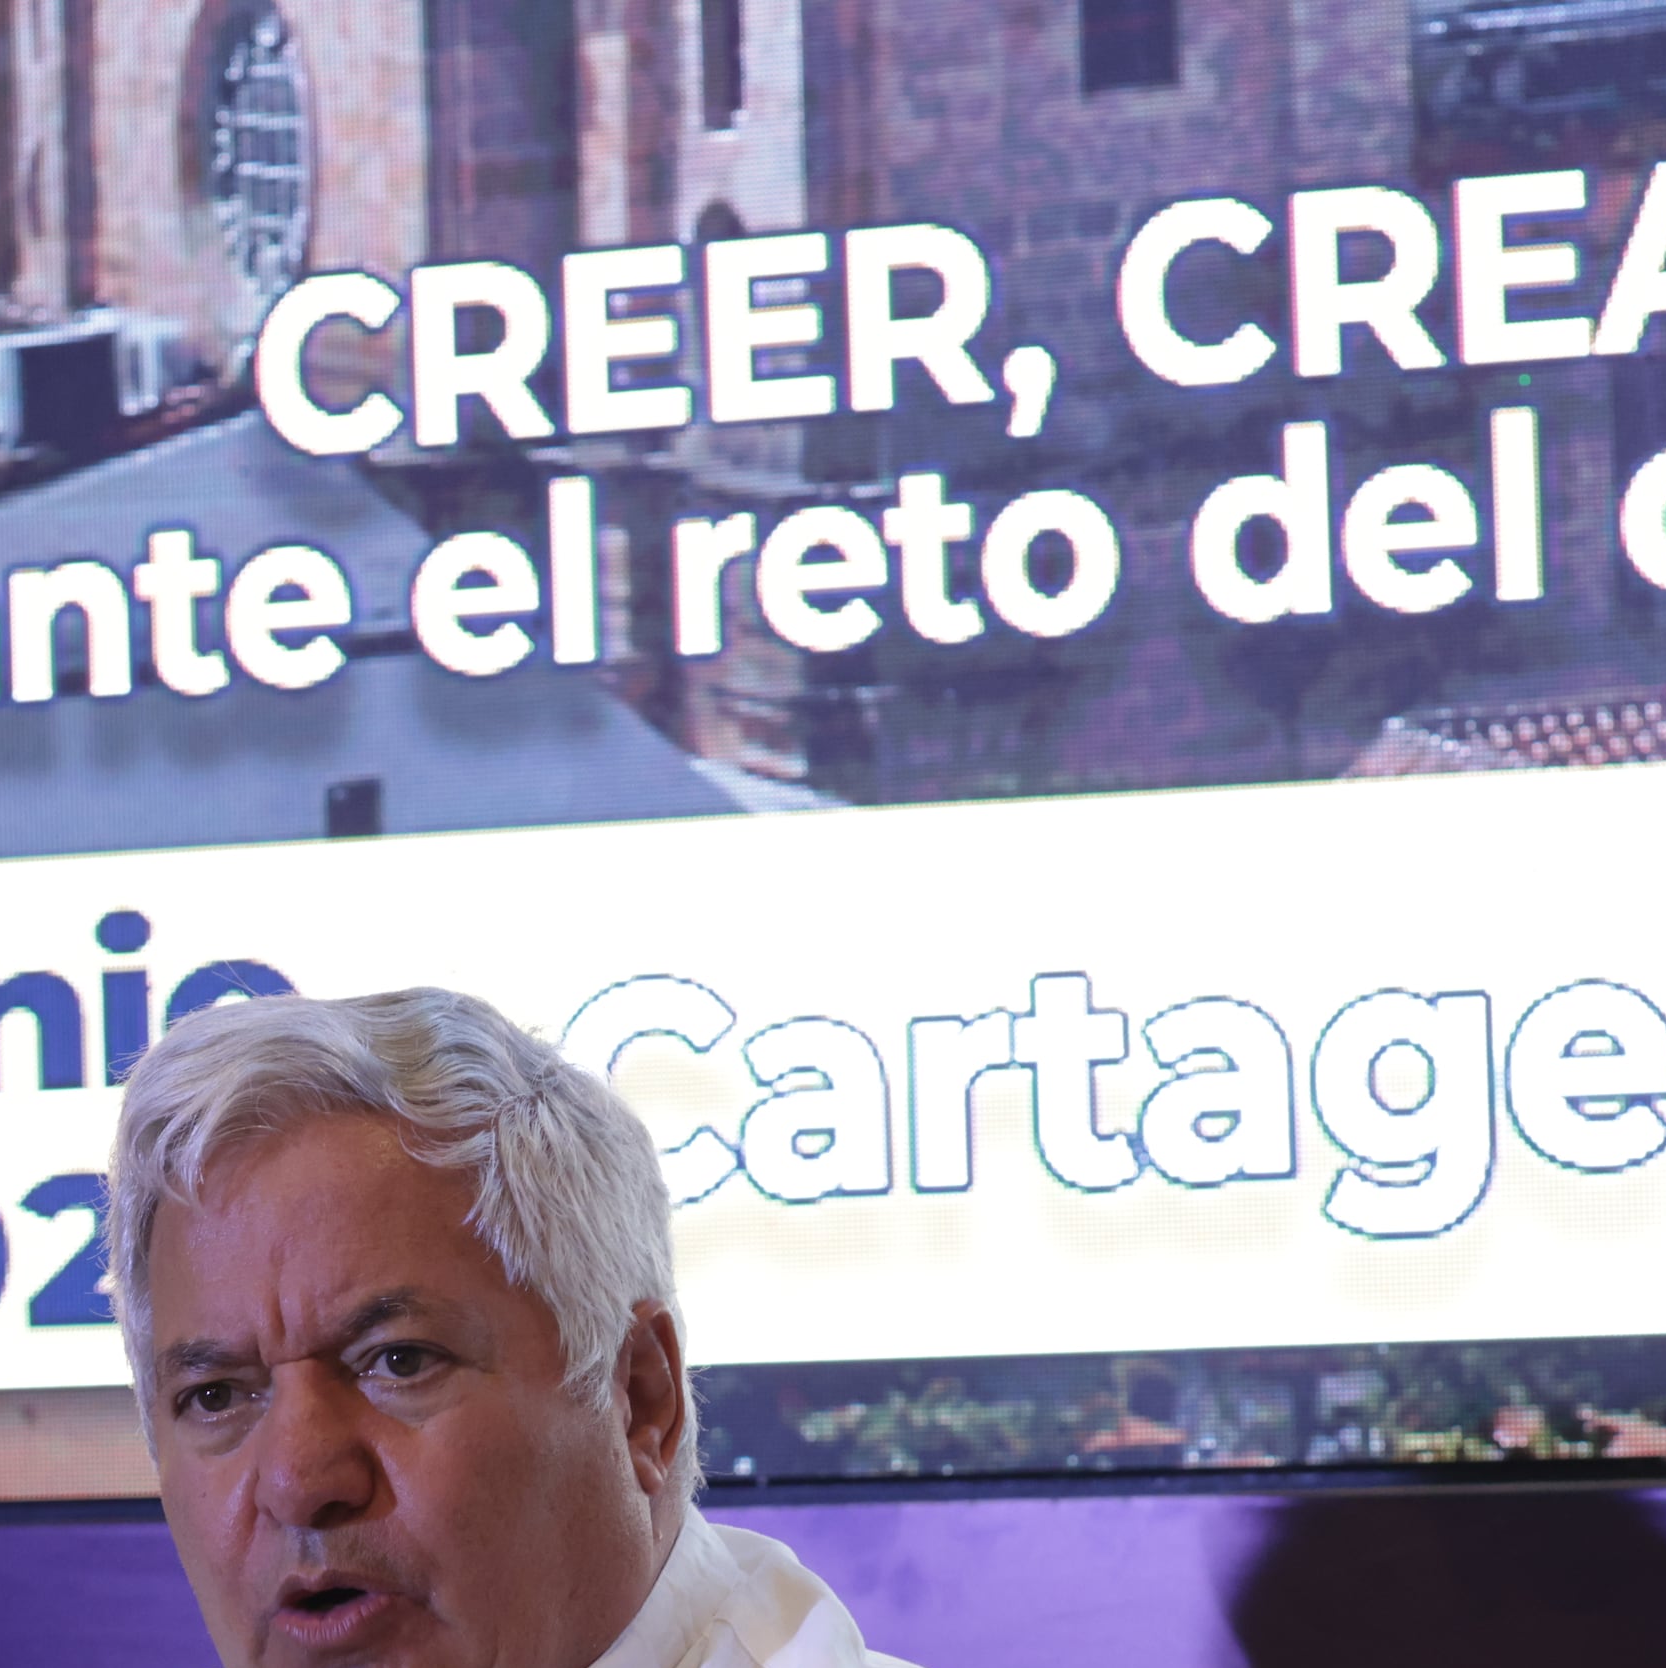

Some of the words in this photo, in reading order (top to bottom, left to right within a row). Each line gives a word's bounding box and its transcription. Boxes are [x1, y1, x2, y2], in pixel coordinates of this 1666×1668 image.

[257, 222, 1057, 457] CREER,
[413, 478, 597, 677] el
[673, 473, 1120, 657] reto
[1191, 408, 1542, 625] del
